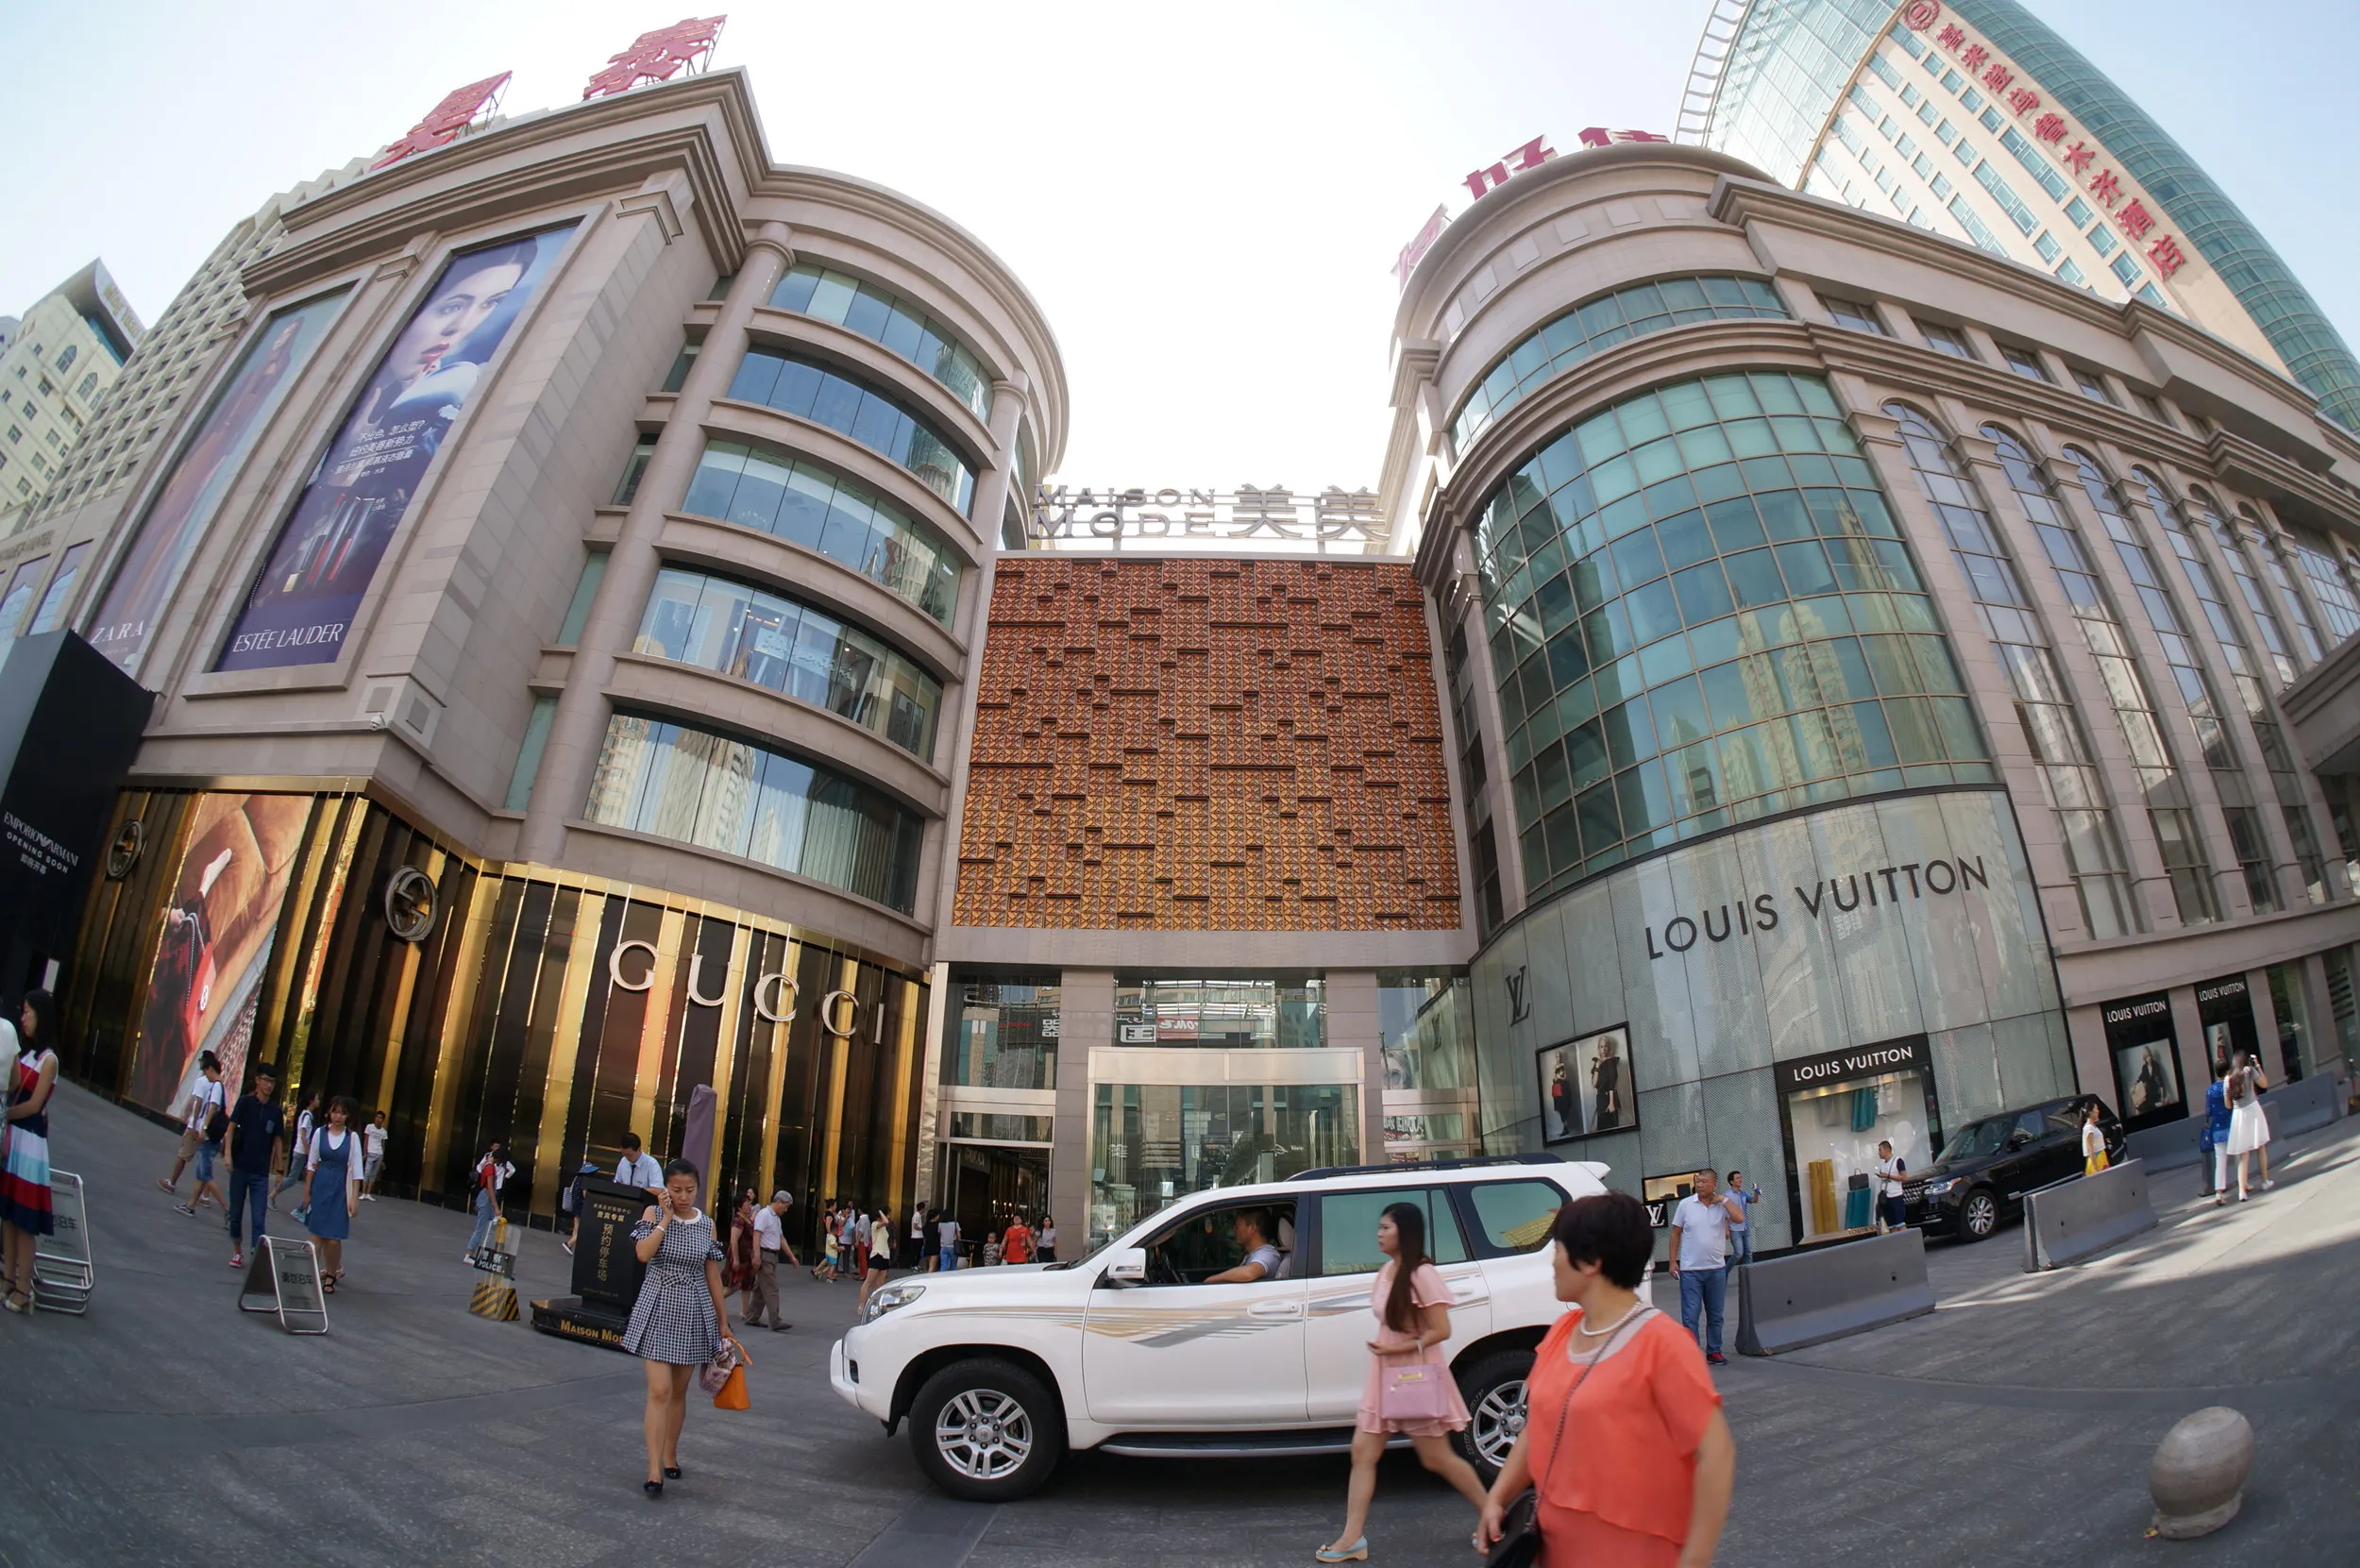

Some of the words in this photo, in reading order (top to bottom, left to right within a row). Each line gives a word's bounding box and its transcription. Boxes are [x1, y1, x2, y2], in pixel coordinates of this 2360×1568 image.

[1033, 483, 1216, 508] MAISON
[1029, 509, 1216, 538] MODE
[1227, 483, 1391, 541] 美美
[91, 620, 143, 645] ZARA
[276, 623, 345, 648] LAUDER
[7, 831, 43, 859] OPENING
[45, 855, 69, 874] SOON
[1645, 894, 1778, 960] LOUIS
[1795, 855, 1990, 919] VUITTON
[609, 939, 885, 1044] GUCCI
[2199, 987, 2218, 1002] LOUIS
[2218, 981, 2246, 996] VUITTON
[2106, 1007, 2132, 1023] LOUIS
[2132, 1001, 2166, 1018] VUITTON
[1794, 1061, 1841, 1082] LOUIS
[1845, 1046, 1913, 1071] VUITTON
[53, 1214, 77, 1231] 泊车
[596, 1222, 614, 1282] 预约停车场
